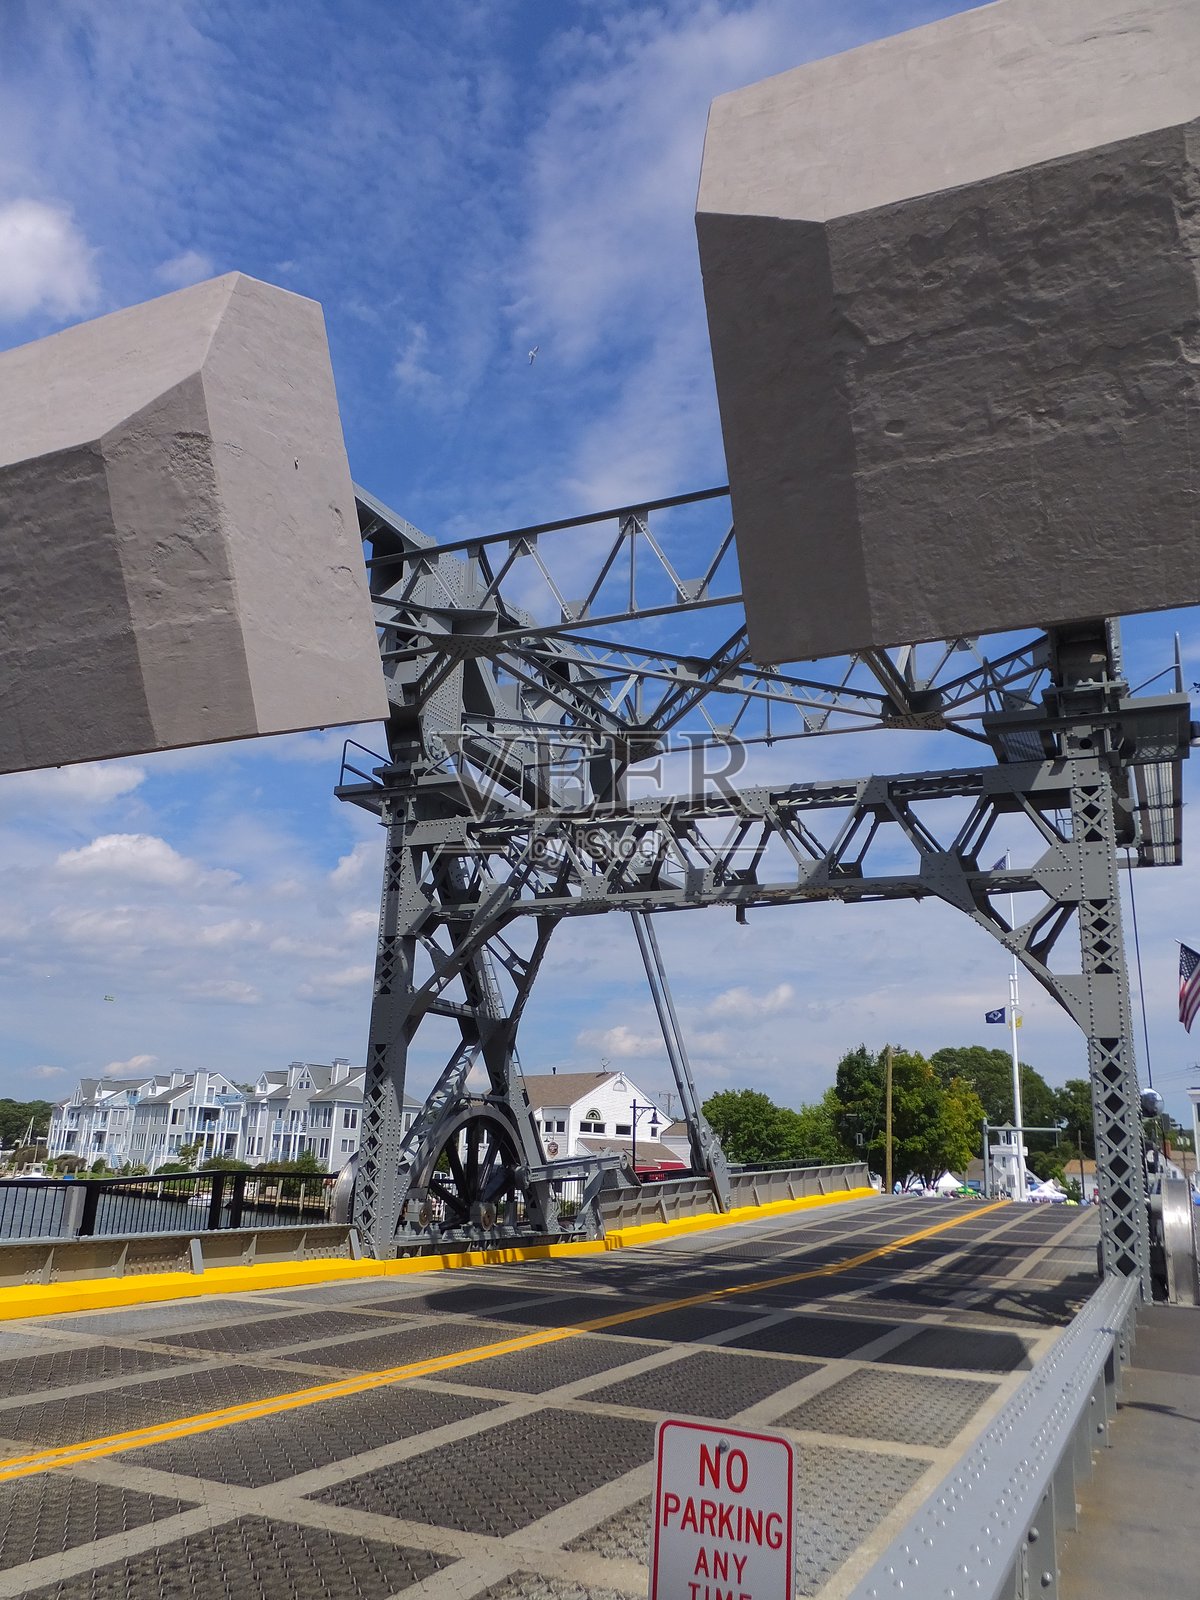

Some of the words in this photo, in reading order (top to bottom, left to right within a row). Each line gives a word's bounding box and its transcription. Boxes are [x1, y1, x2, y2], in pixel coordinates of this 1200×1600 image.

[699, 1443, 749, 1493] NO
[663, 1492, 783, 1550] PARKING
[694, 1546, 748, 1585] ANY
